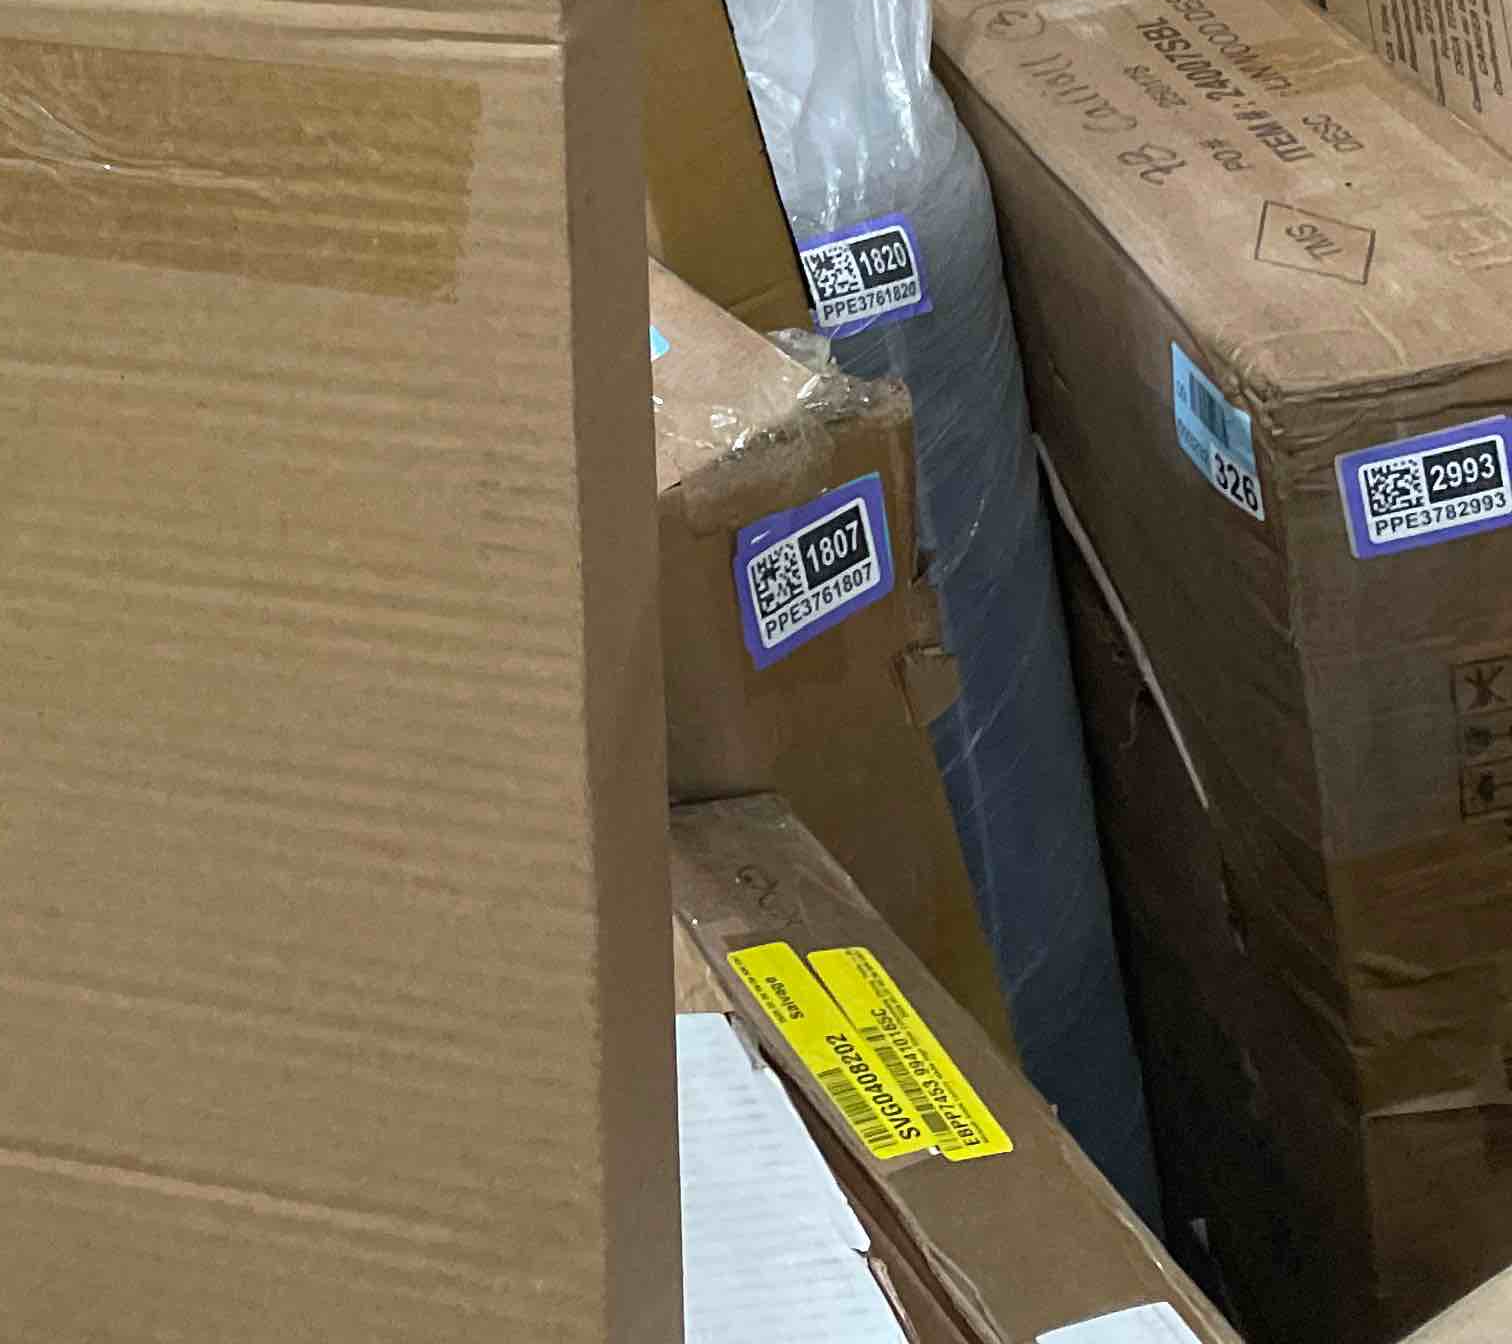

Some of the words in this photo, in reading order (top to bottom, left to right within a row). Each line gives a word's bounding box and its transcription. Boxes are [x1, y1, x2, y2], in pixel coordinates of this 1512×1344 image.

[859, 242, 906, 277] 1820
[823, 282, 918, 321] PPE3761820
[1214, 453, 1258, 512] 326
[1430, 453, 1495, 491] 2993
[1376, 493, 1507, 536] PPE3782993
[805, 521, 860, 574] 1807
[765, 563, 873, 639] PPE3761807
[825, 1033, 921, 1141] SVG0408202
